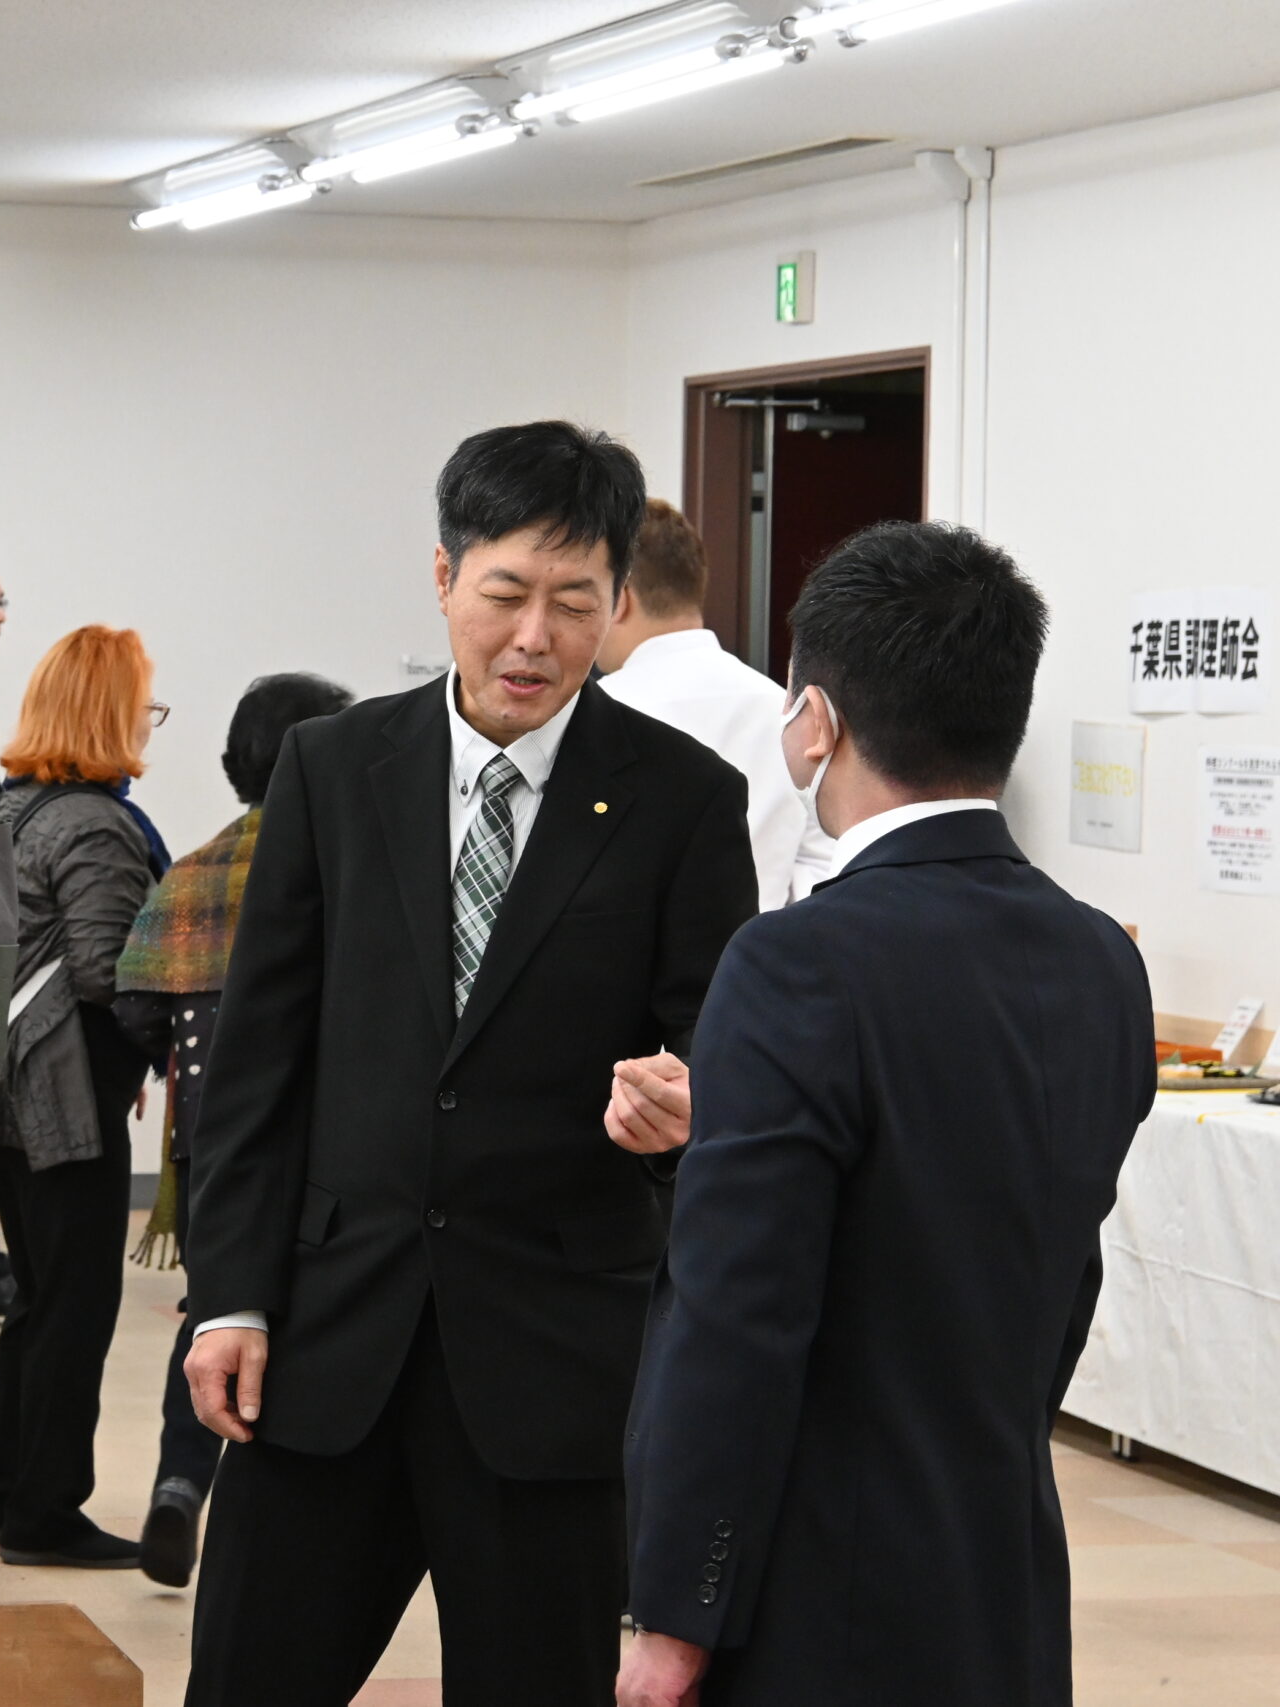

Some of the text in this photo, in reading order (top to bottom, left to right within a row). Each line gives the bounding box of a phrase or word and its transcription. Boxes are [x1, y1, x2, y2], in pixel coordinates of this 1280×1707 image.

[1129, 617, 1260, 682] 千葉県調理師会
